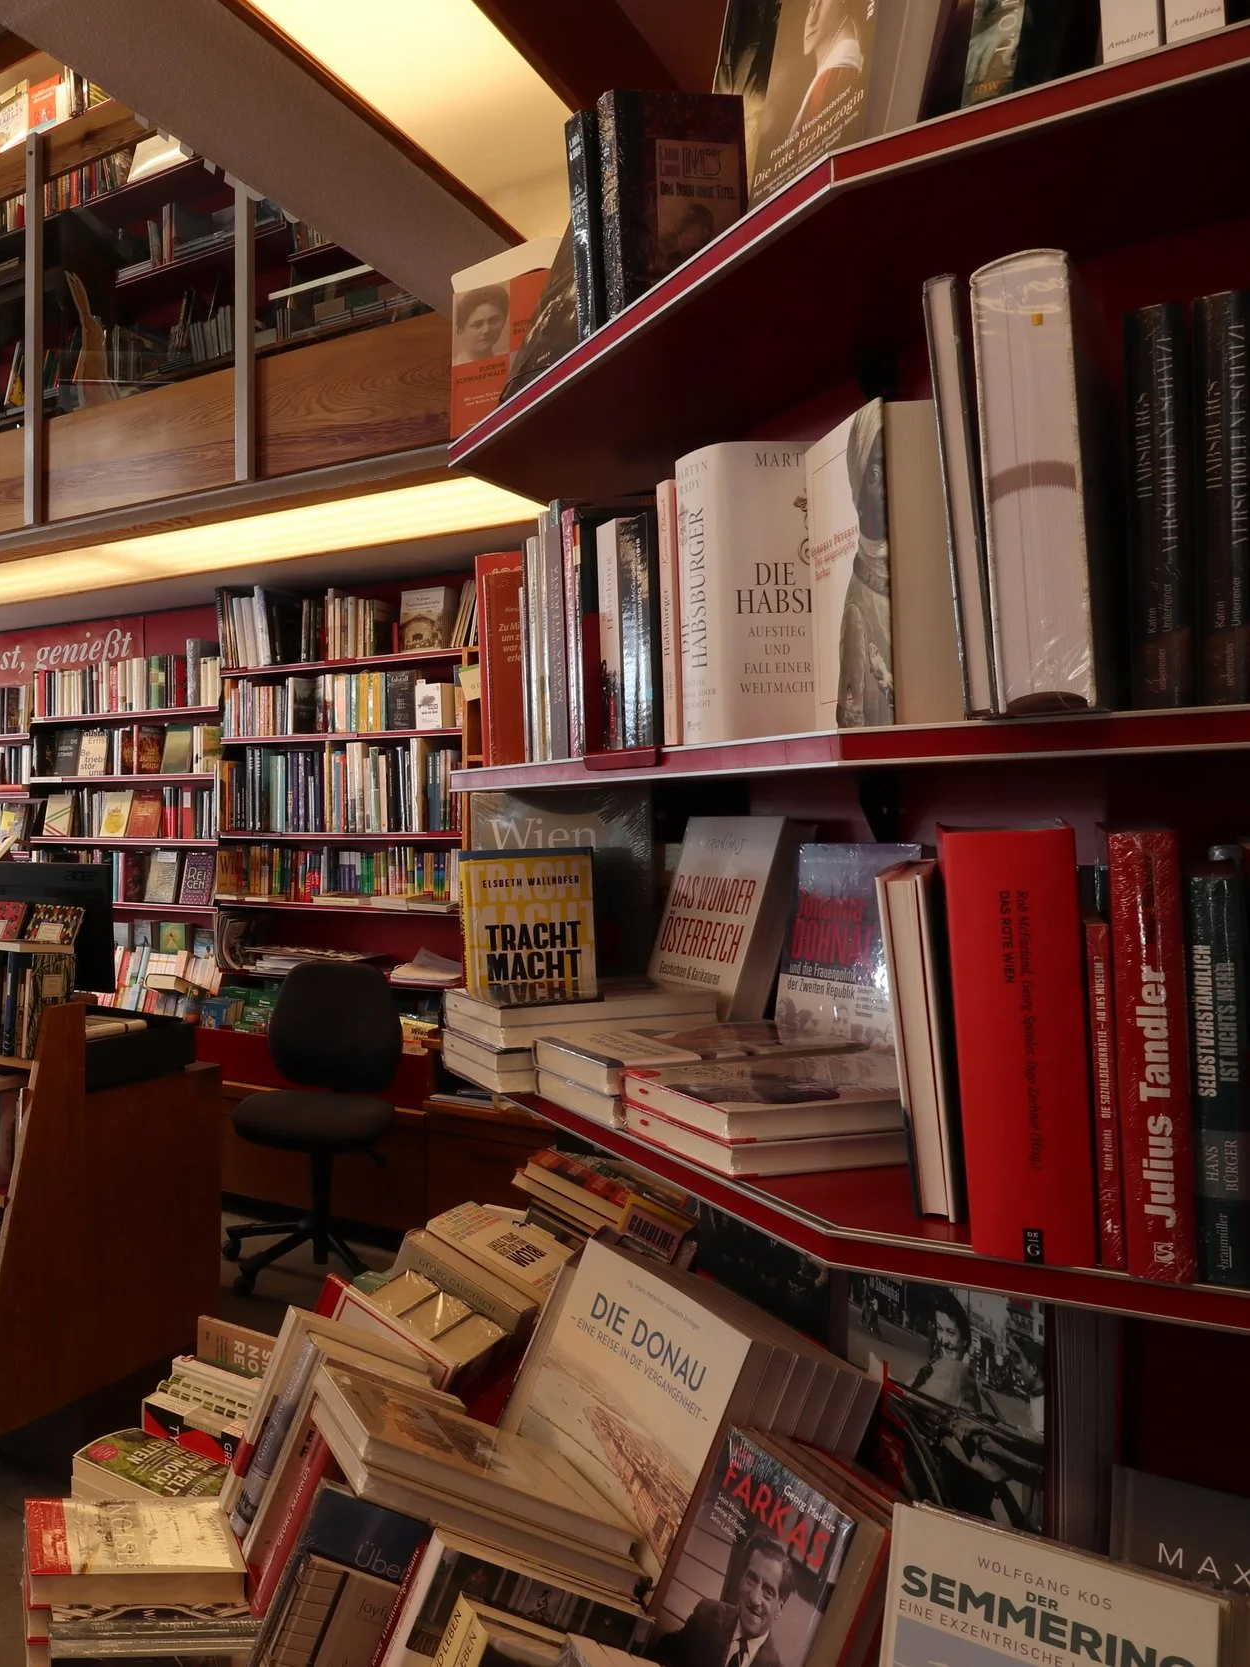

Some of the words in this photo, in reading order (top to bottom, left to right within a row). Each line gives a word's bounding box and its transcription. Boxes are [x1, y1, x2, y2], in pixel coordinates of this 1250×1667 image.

[1170, 5, 1222, 29] Amalthea
[1106, 27, 1156, 51] Amalthea
[753, 166, 772, 188] Die
[773, 147, 796, 173] rote
[797, 88, 864, 154] Erzherzogin
[769, 131, 801, 160] Friedrich
[801, 85, 852, 132] Weissensteiner
[456, 369, 507, 386] SCHWARZWALD
[478, 361, 507, 374] EUGENIE
[1135, 392, 1153, 499] HABSBURGS
[1205, 379, 1222, 490] HABSBURGS
[1157, 418, 1179, 553] VERSCHOLLENE
[1229, 409, 1249, 546] VERSCHOLLENE
[688, 506, 708, 670] HABSBURGER
[754, 561, 797, 586] DIE
[552, 564, 563, 645] THERESIA
[604, 556, 614, 631] Habsburg
[1161, 582, 1173, 633] Unterreiner
[1231, 574, 1243, 628] Unterreiner
[498, 623, 510, 632] Zu
[662, 588, 670, 658] Habsburger
[1146, 606, 1157, 634] Katrin
[1213, 598, 1225, 630] Katrin
[501, 634, 514, 642] um
[502, 644, 519, 652] war
[748, 625, 807, 639] AUFSTIEG
[33, 628, 133, 671] genießt
[764, 644, 791, 656] UND
[554, 648, 564, 703] MARIA
[744, 662, 771, 675] FALL
[775, 661, 812, 674] EINER
[1157, 646, 1167, 692] ueberreuter
[487, 816, 597, 850] Wien
[187, 866, 207, 880] REI
[482, 877, 523, 889] ELSBETH
[527, 874, 581, 887] WALLNÖFER
[671, 874, 697, 908] DAS
[699, 876, 757, 916] WUNDER
[999, 890, 1012, 915] DAS
[1016, 890, 1031, 914] Rob
[485, 920, 582, 952] TRACHT
[659, 910, 745, 965] ÖSTERREICH
[1000, 917, 1014, 949] ROTE
[1017, 914, 1035, 976] McFarland,
[487, 949, 582, 982] MACHT
[658, 960, 687, 978] Geschichten
[686, 966, 692, 978] &
[691, 968, 721, 986] Karikaturen
[789, 962, 802, 975] und
[802, 964, 813, 977] die
[814, 965, 858, 984] Frauenpolitik
[1002, 951, 1016, 985] WIEN
[1093, 961, 1106, 995] MUSEUM
[1215, 961, 1237, 1001] MEHR
[787, 977, 799, 991] der
[799, 979, 825, 995] Zweiten
[825, 983, 856, 1000] Republik
[1019, 979, 1037, 1012] Georg
[1134, 963, 1172, 1103] Tandler
[1192, 944, 1218, 1098] SELBSTVERSTÄNDLICH
[1216, 1003, 1239, 1058] NICHTS
[1022, 1059, 1041, 1085] Ingo
[1096, 1029, 1111, 1105] SOZIALDEMOKRATIE
[1219, 1058, 1240, 1083] IST
[1025, 1086, 1043, 1130] Zechner
[1100, 1105, 1112, 1120] DIE
[1142, 1113, 1176, 1230] Julius
[1205, 1143, 1221, 1185] HANS
[1222, 1138, 1239, 1193] BÜRGER
[629, 1213, 677, 1248] CAROLINE
[1026, 1231, 1040, 1239] DE
[1217, 1212, 1232, 1272] braumüller
[505, 1243, 548, 1268] BLOM
[1025, 1241, 1041, 1258] G
[418, 1257, 450, 1282] GEORG
[449, 1278, 497, 1314] GAUGUSCH
[590, 1291, 631, 1337] DIE
[630, 1317, 709, 1393] DONAU
[577, 1316, 597, 1337] EINE
[596, 1329, 619, 1354] REISE
[619, 1344, 630, 1359] IN
[630, 1350, 644, 1367] DIE
[643, 1364, 702, 1420] VERGANGENHEIT
[150, 1459, 185, 1485] NOCH
[200, 1457, 217, 1471] DIE
[166, 1468, 201, 1497] WELT
[276, 1508, 295, 1548] GEORG
[291, 1466, 311, 1510] MARKUS
[713, 1501, 730, 1520] Seine
[728, 1510, 748, 1538] Erfolge.
[717, 1490, 731, 1507] Sein
[729, 1498, 747, 1523] Humor.
[722, 1462, 831, 1570] FARKAS
[782, 1485, 806, 1512] Georg
[805, 1501, 837, 1535] Markus
[709, 1513, 722, 1527] Sein
[720, 1522, 738, 1543] Leben.
[977, 1554, 1070, 1596] WOLFGANG
[1077, 1591, 1114, 1611] KOS
[1025, 1591, 1059, 1613] DER
[441, 1608, 463, 1653] LEBEN
[899, 1598, 933, 1622] EINE
[939, 1612, 1064, 1667] EXZENTRISCHE
